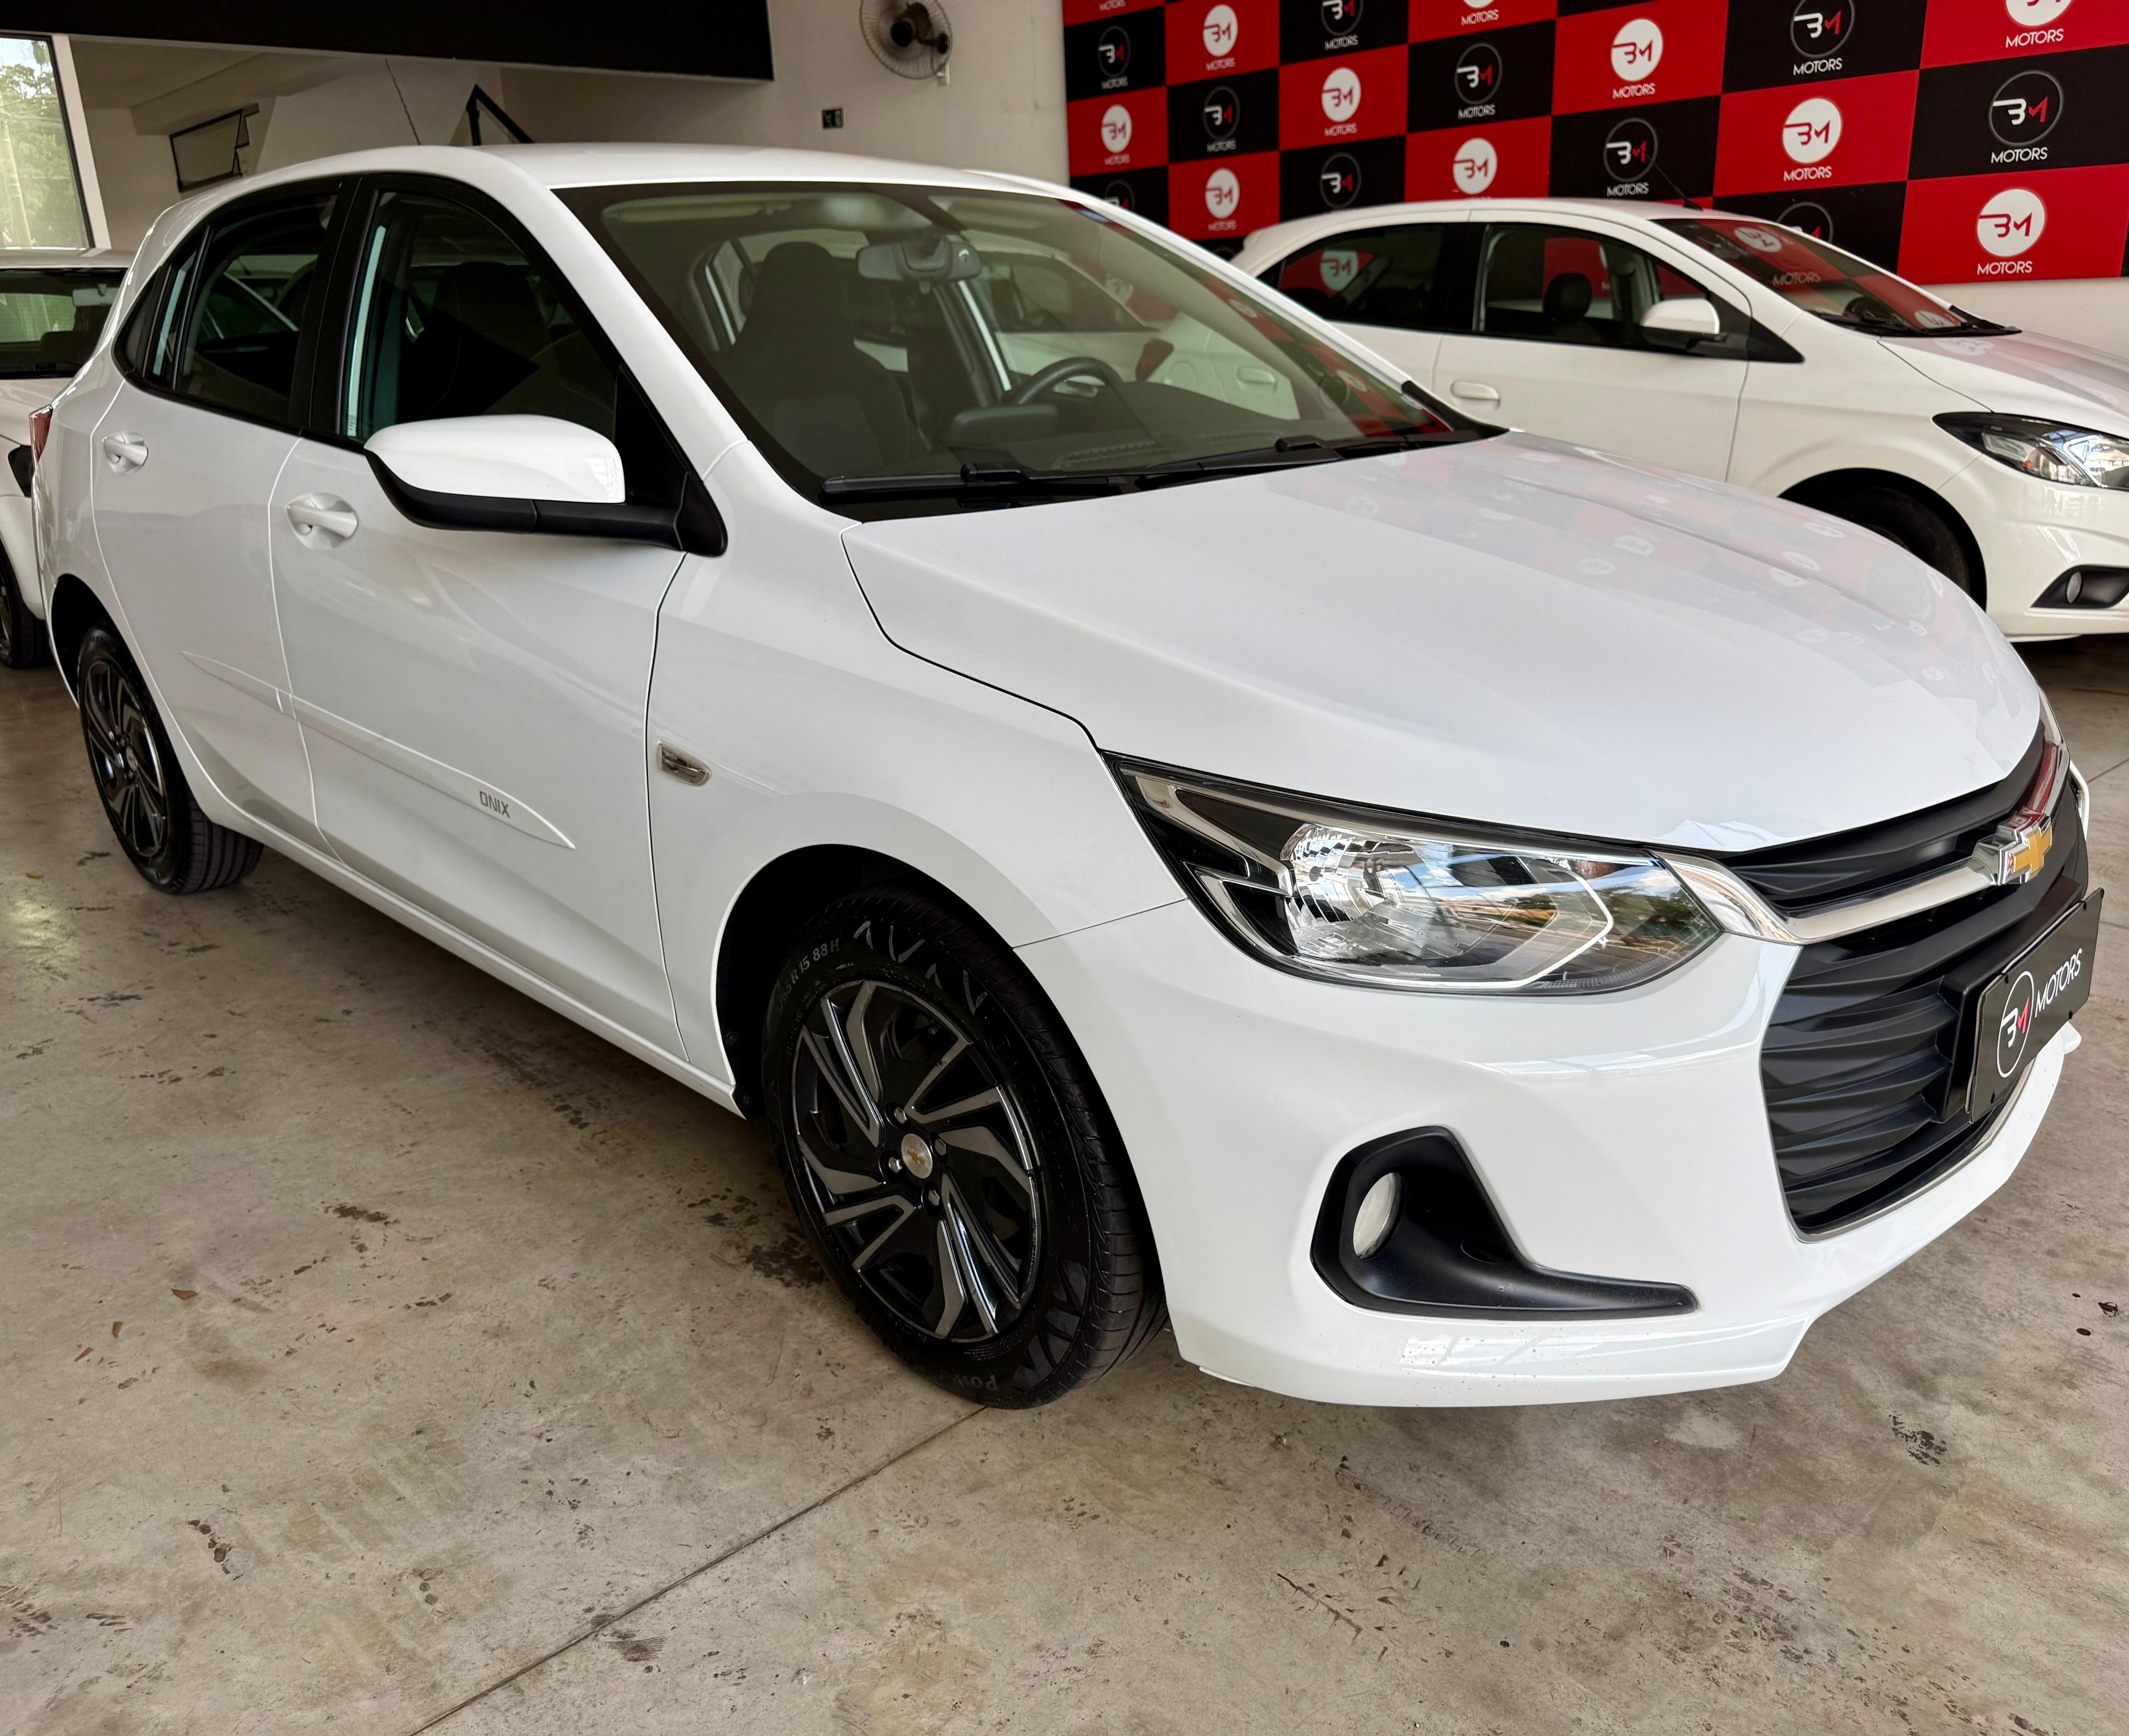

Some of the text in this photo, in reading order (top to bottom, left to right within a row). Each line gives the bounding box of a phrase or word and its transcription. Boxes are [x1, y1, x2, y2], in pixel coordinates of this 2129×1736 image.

[1461, 9, 1499, 25] MOTORS
[1324, 34, 1358, 50] MOTORS
[2006, 29, 2063, 48] MOTORS
[1793, 58, 1842, 75] MOTORS
[1613, 83, 1655, 98] MOTORS
[1459, 104, 1495, 119] MOTORS
[1324, 122, 1357, 137] MOTORS
[1991, 147, 2048, 164] MOTORS
[1784, 166, 1832, 181] MOTORS
[1607, 182, 1648, 197] MOTORS
[1978, 262, 2032, 275] MOTORS
[480, 790, 510, 818] ONIX
[2034, 948, 2082, 1018] MOTORS
